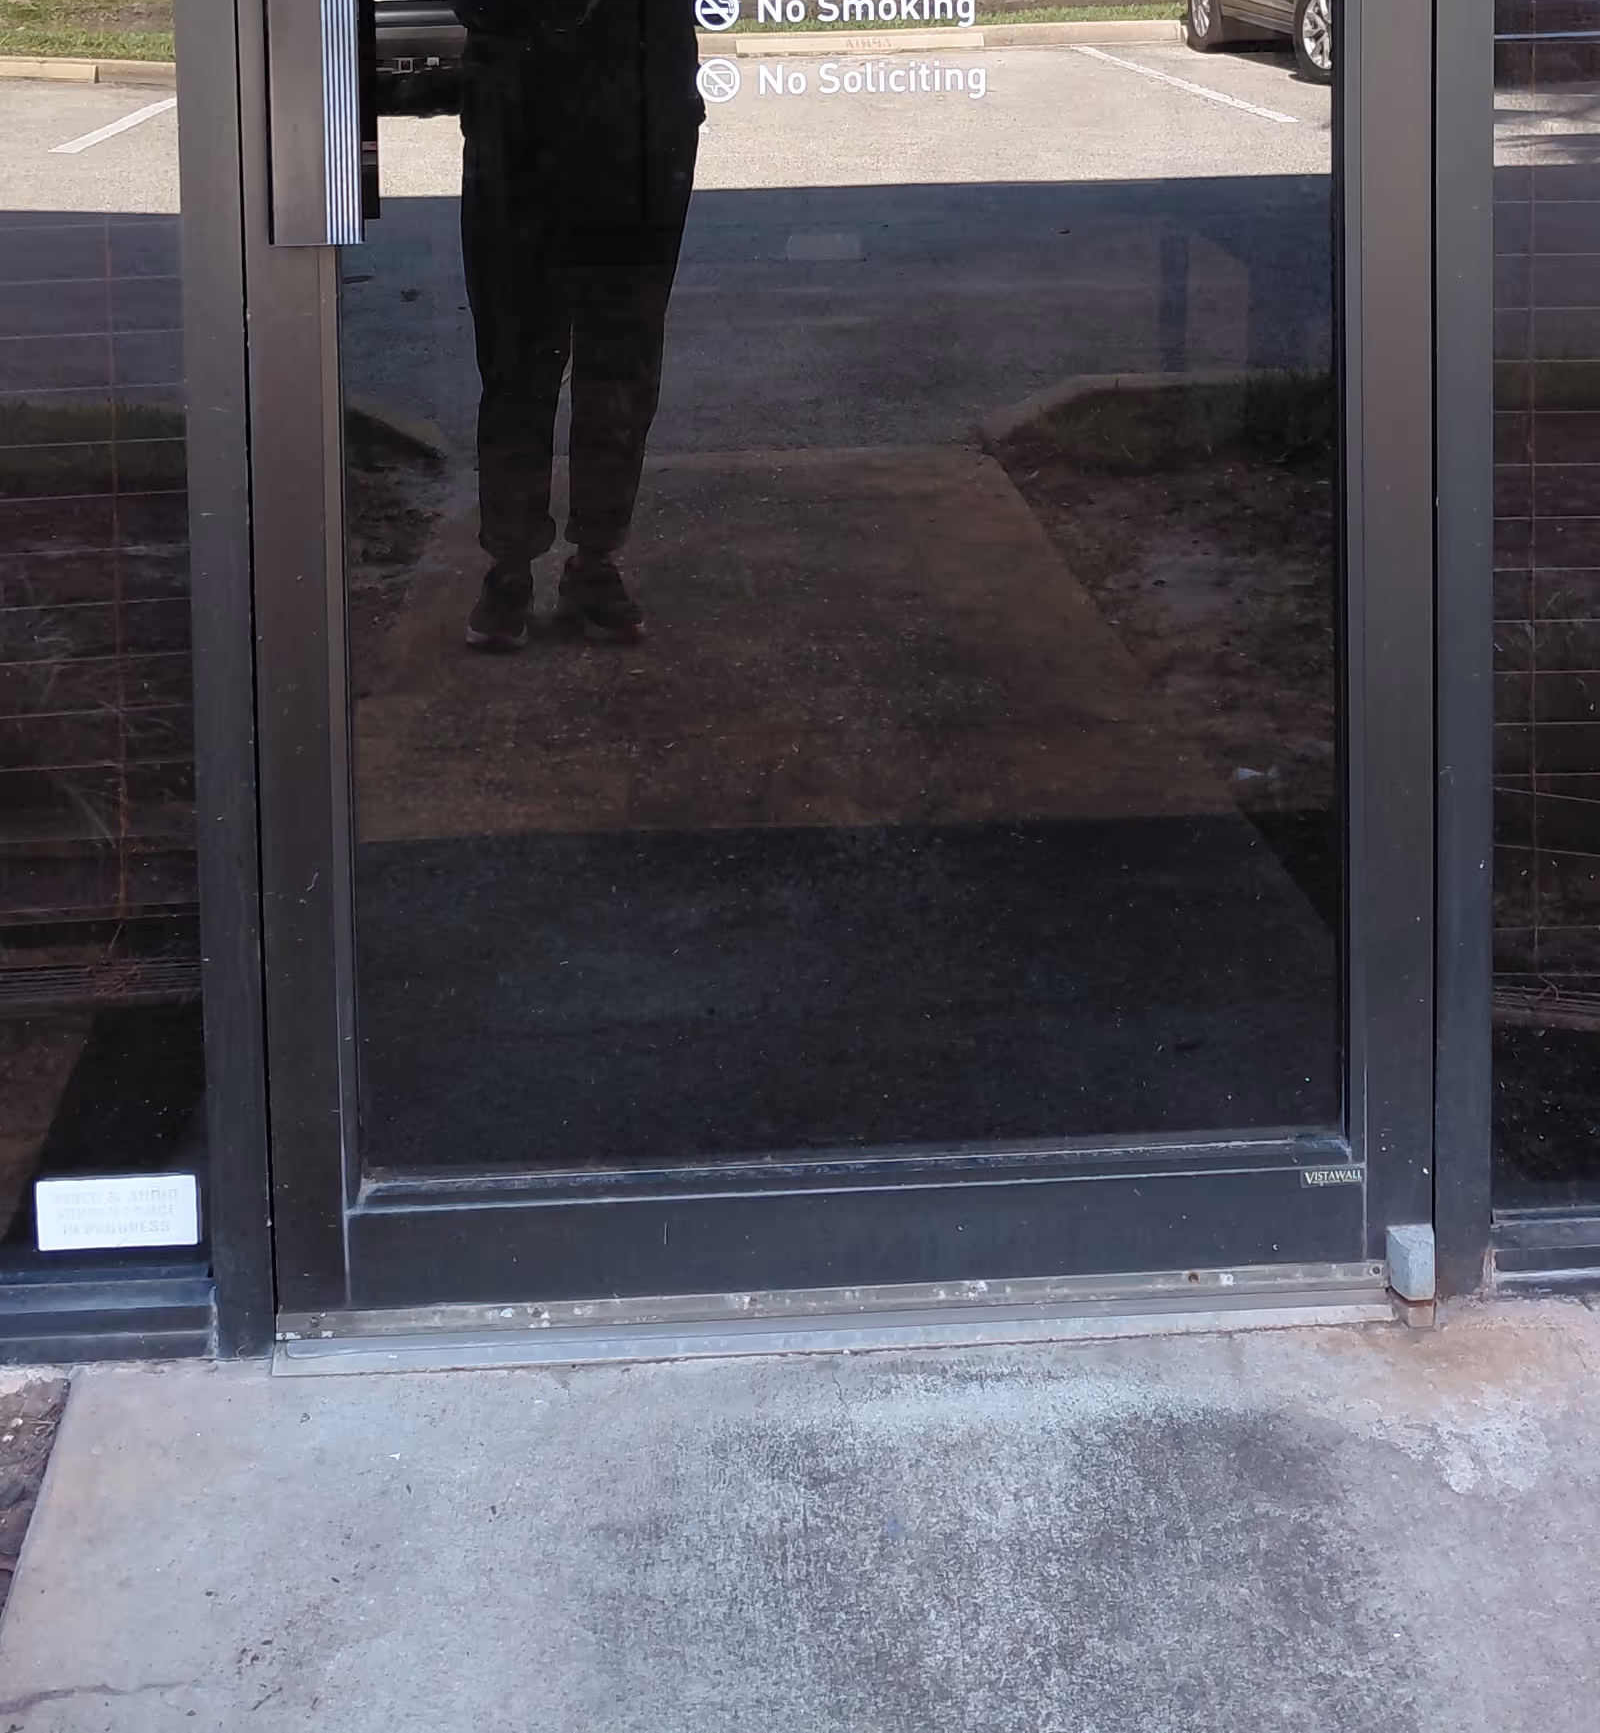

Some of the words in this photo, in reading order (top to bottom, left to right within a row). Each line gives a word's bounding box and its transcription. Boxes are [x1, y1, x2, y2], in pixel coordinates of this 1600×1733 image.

[758, 64, 807, 95] No
[819, 61, 987, 99] Soliciting
[1304, 1169, 1362, 1185] VISTAWALL
